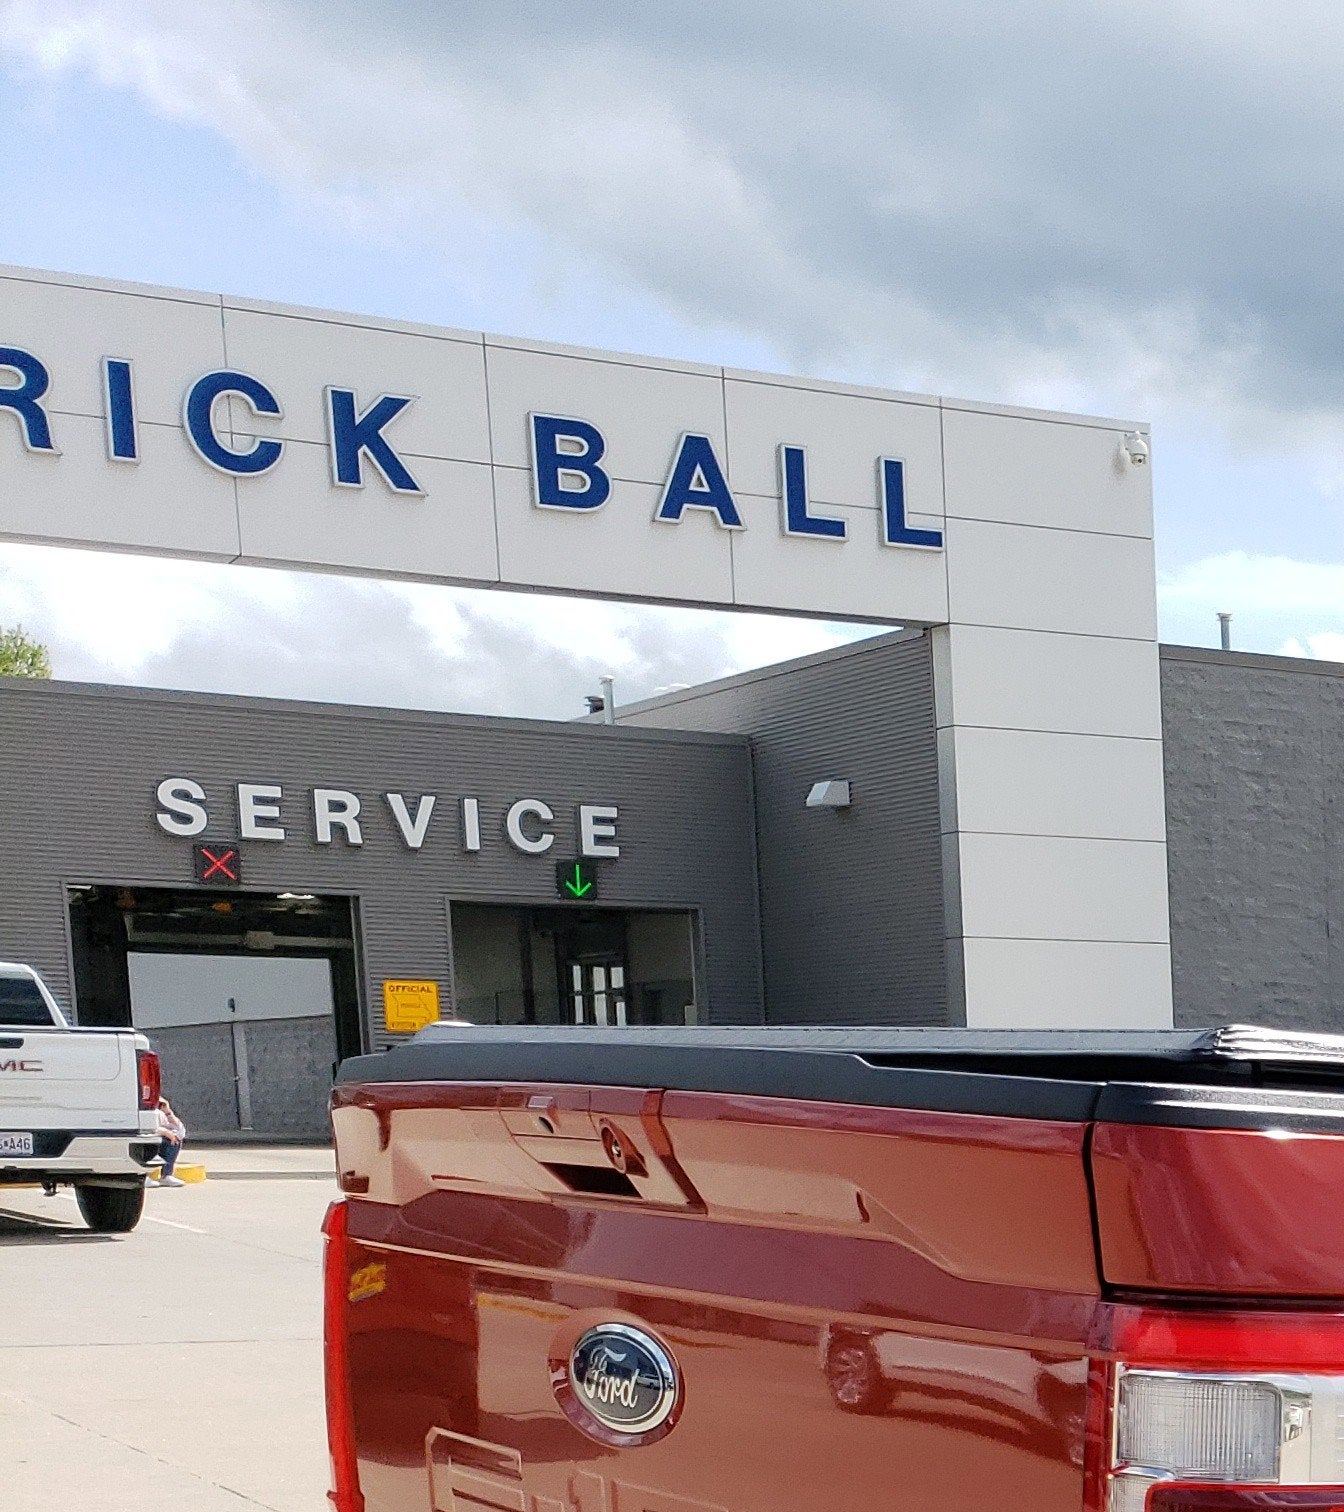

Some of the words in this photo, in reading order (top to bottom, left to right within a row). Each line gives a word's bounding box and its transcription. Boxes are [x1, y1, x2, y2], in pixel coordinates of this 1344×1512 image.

[0, 343, 428, 497] RICK
[527, 410, 945, 553] BALL
[154, 776, 623, 860] SERVICE
[388, 984, 433, 994] OFFICIAL
[583, 1345, 641, 1409] Ford
